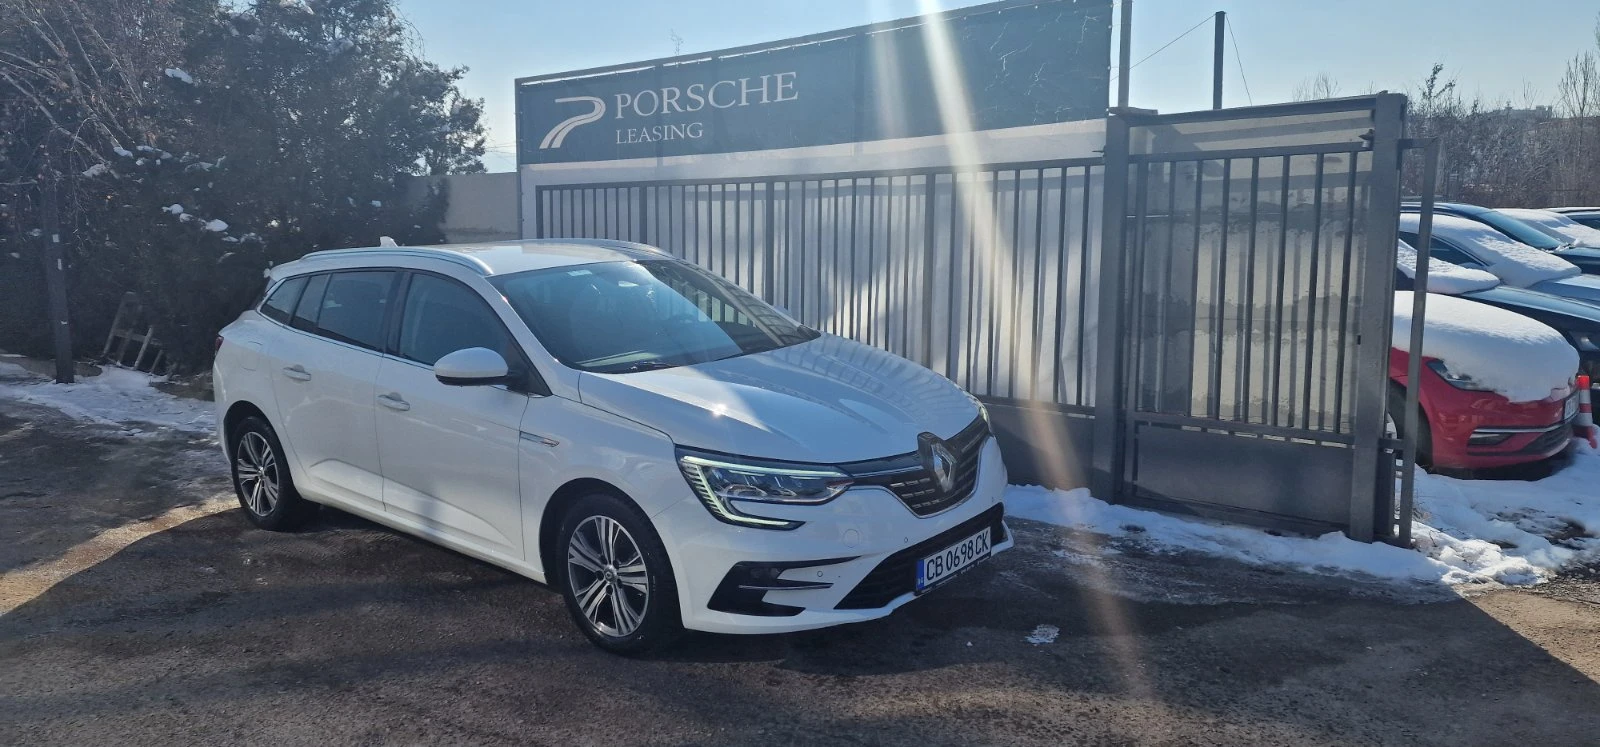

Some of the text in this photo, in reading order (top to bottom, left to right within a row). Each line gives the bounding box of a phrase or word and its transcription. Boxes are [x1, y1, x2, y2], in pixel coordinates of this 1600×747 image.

[614, 71, 799, 119] PORSCHE
[616, 122, 703, 144] LEASING
[926, 555, 944, 581] CB
[945, 539, 974, 571] 0698
[975, 530, 989, 556] CK
